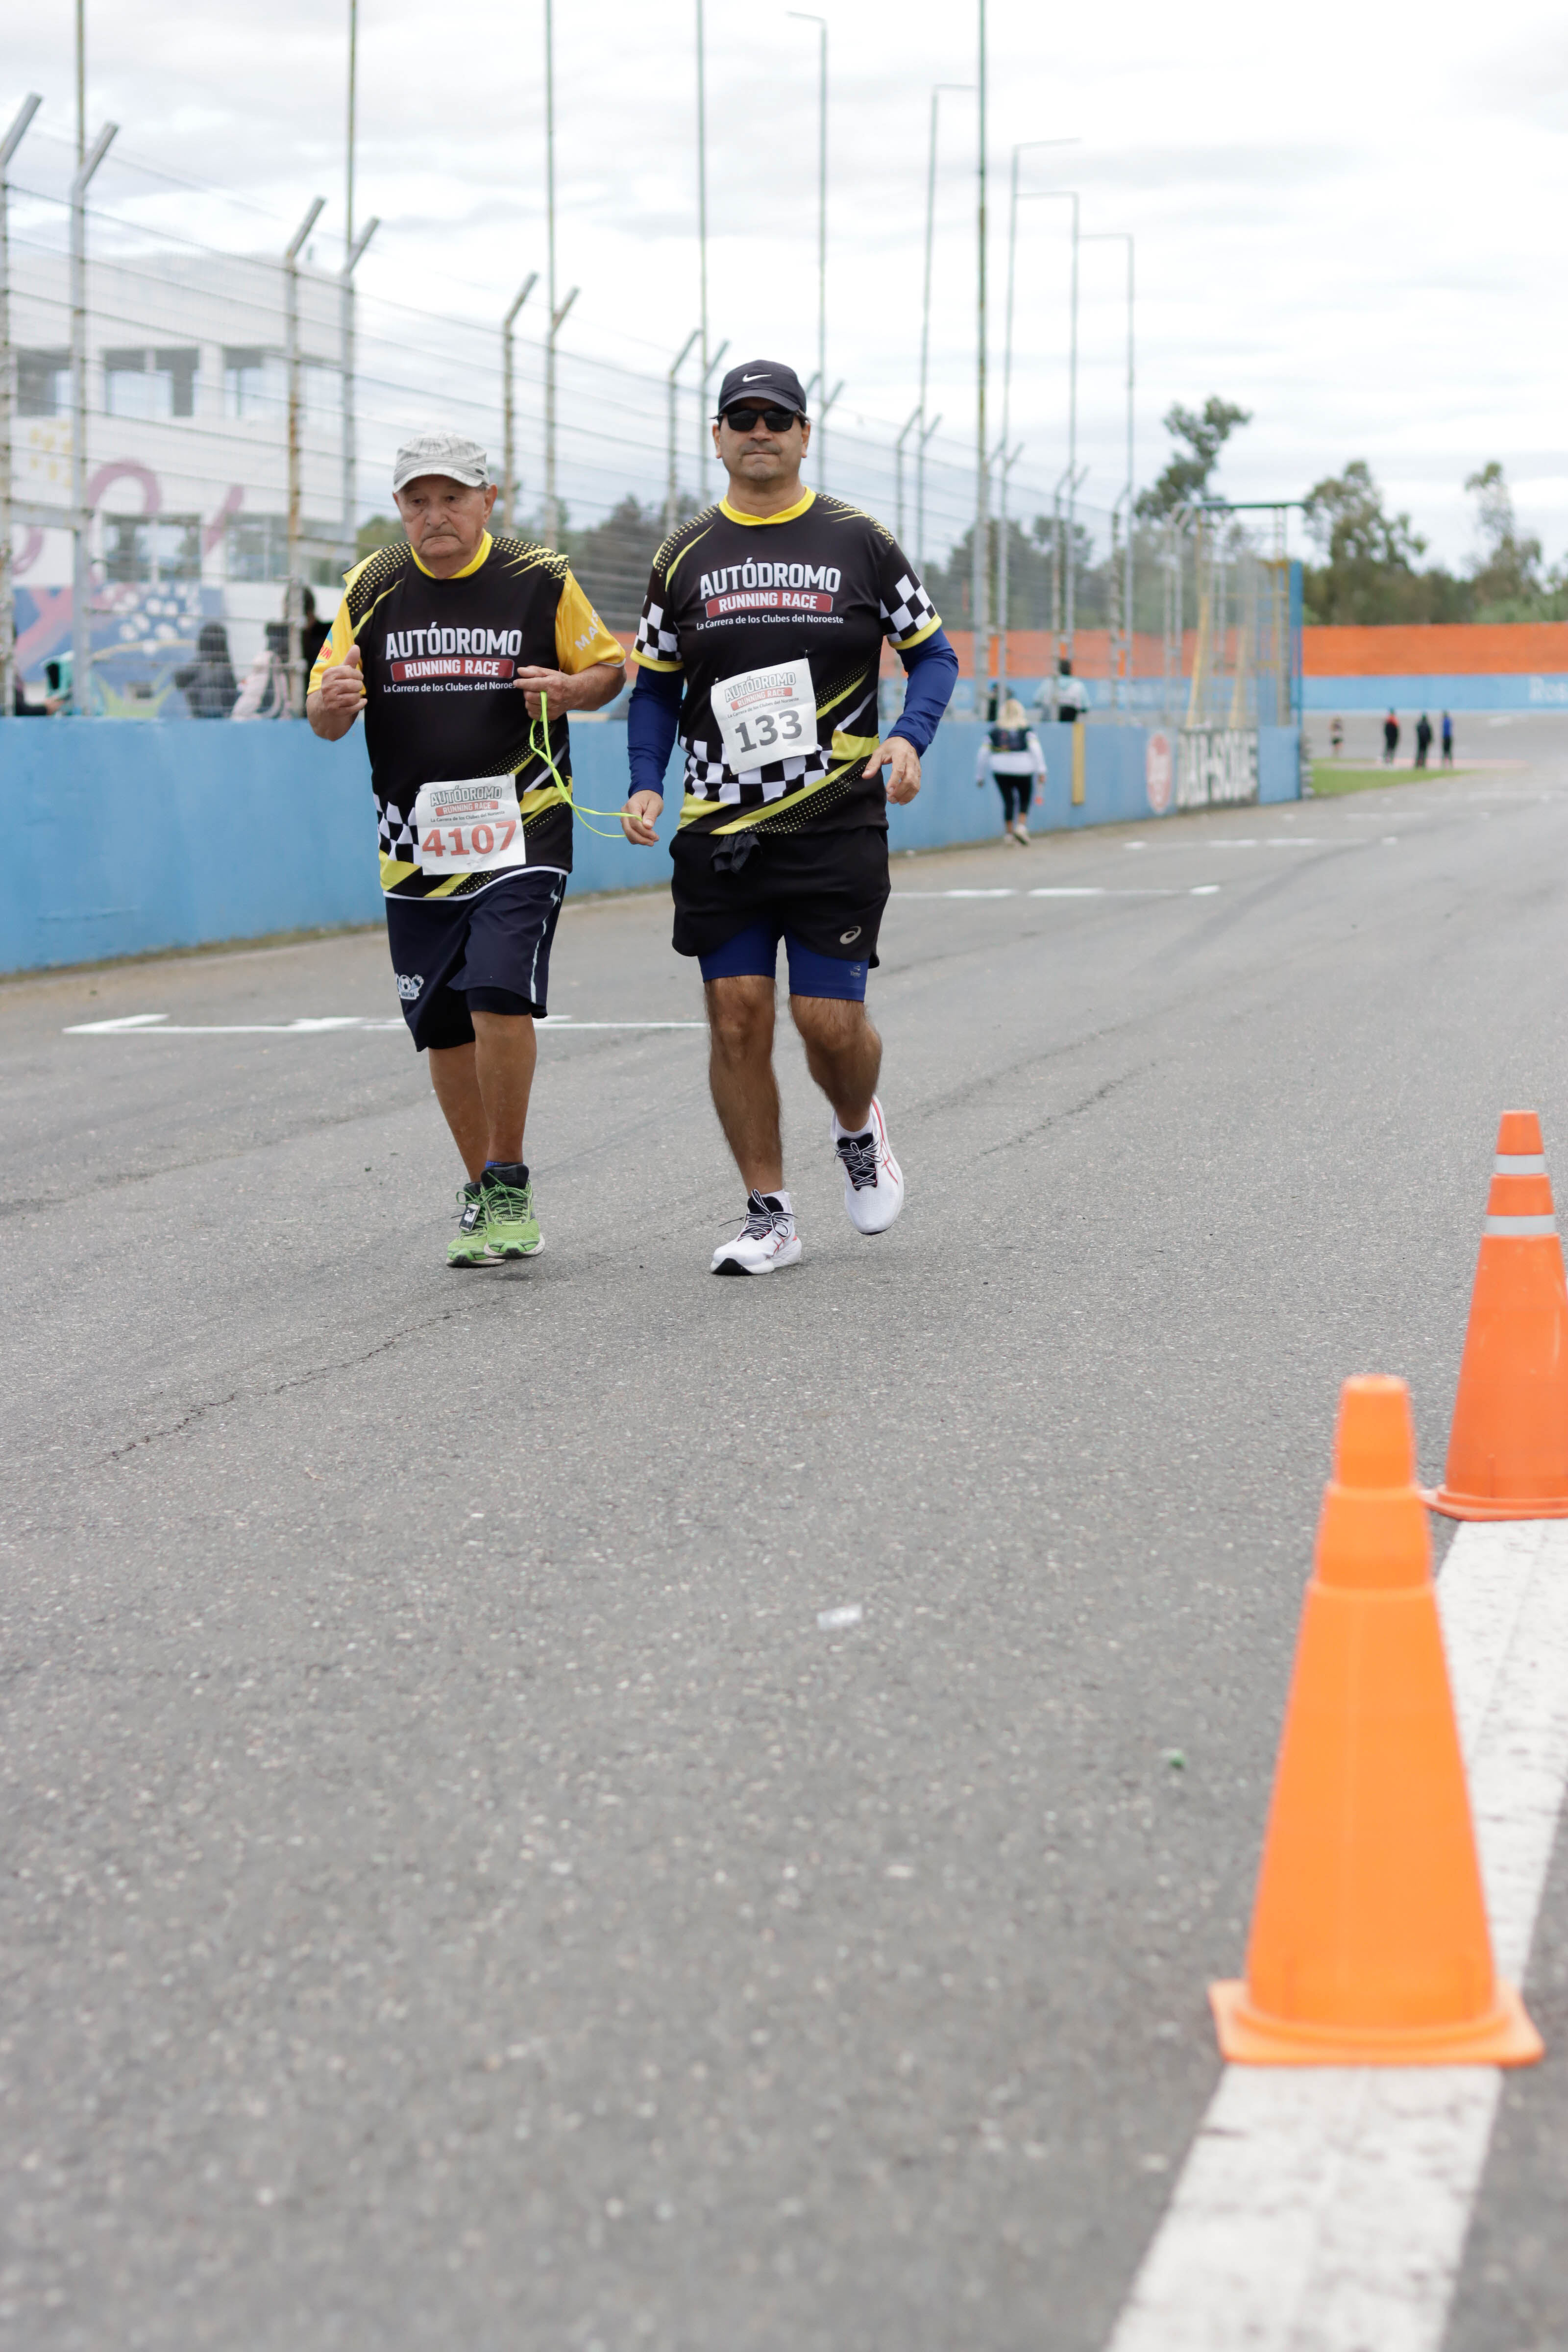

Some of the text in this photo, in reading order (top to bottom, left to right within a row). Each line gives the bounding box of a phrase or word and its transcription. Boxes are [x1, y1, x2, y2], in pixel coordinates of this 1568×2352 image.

[700, 557, 841, 600] AUTÓDROMO
[719, 592, 818, 612] RUNNING RACE
[705, 618, 734, 628] Carrera
[735, 615, 746, 624] de
[748, 615, 760, 623] los
[762, 614, 790, 623] Clubes
[807, 615, 844, 624] Noroeste
[386, 622, 522, 660] AUTÓDROMO
[404, 659, 500, 678] RUNNING RACE
[421, 683, 431, 691] de
[433, 683, 443, 691] los
[445, 682, 472, 690] Clubes
[725, 672, 795, 702] AUTÓDROMO
[737, 689, 785, 707] RUNNING RACE
[735, 710, 802, 753] 133
[430, 785, 502, 807] AUTÓDROMO
[443, 802, 491, 815] RUNNING RACE
[422, 820, 516, 857] 4107
